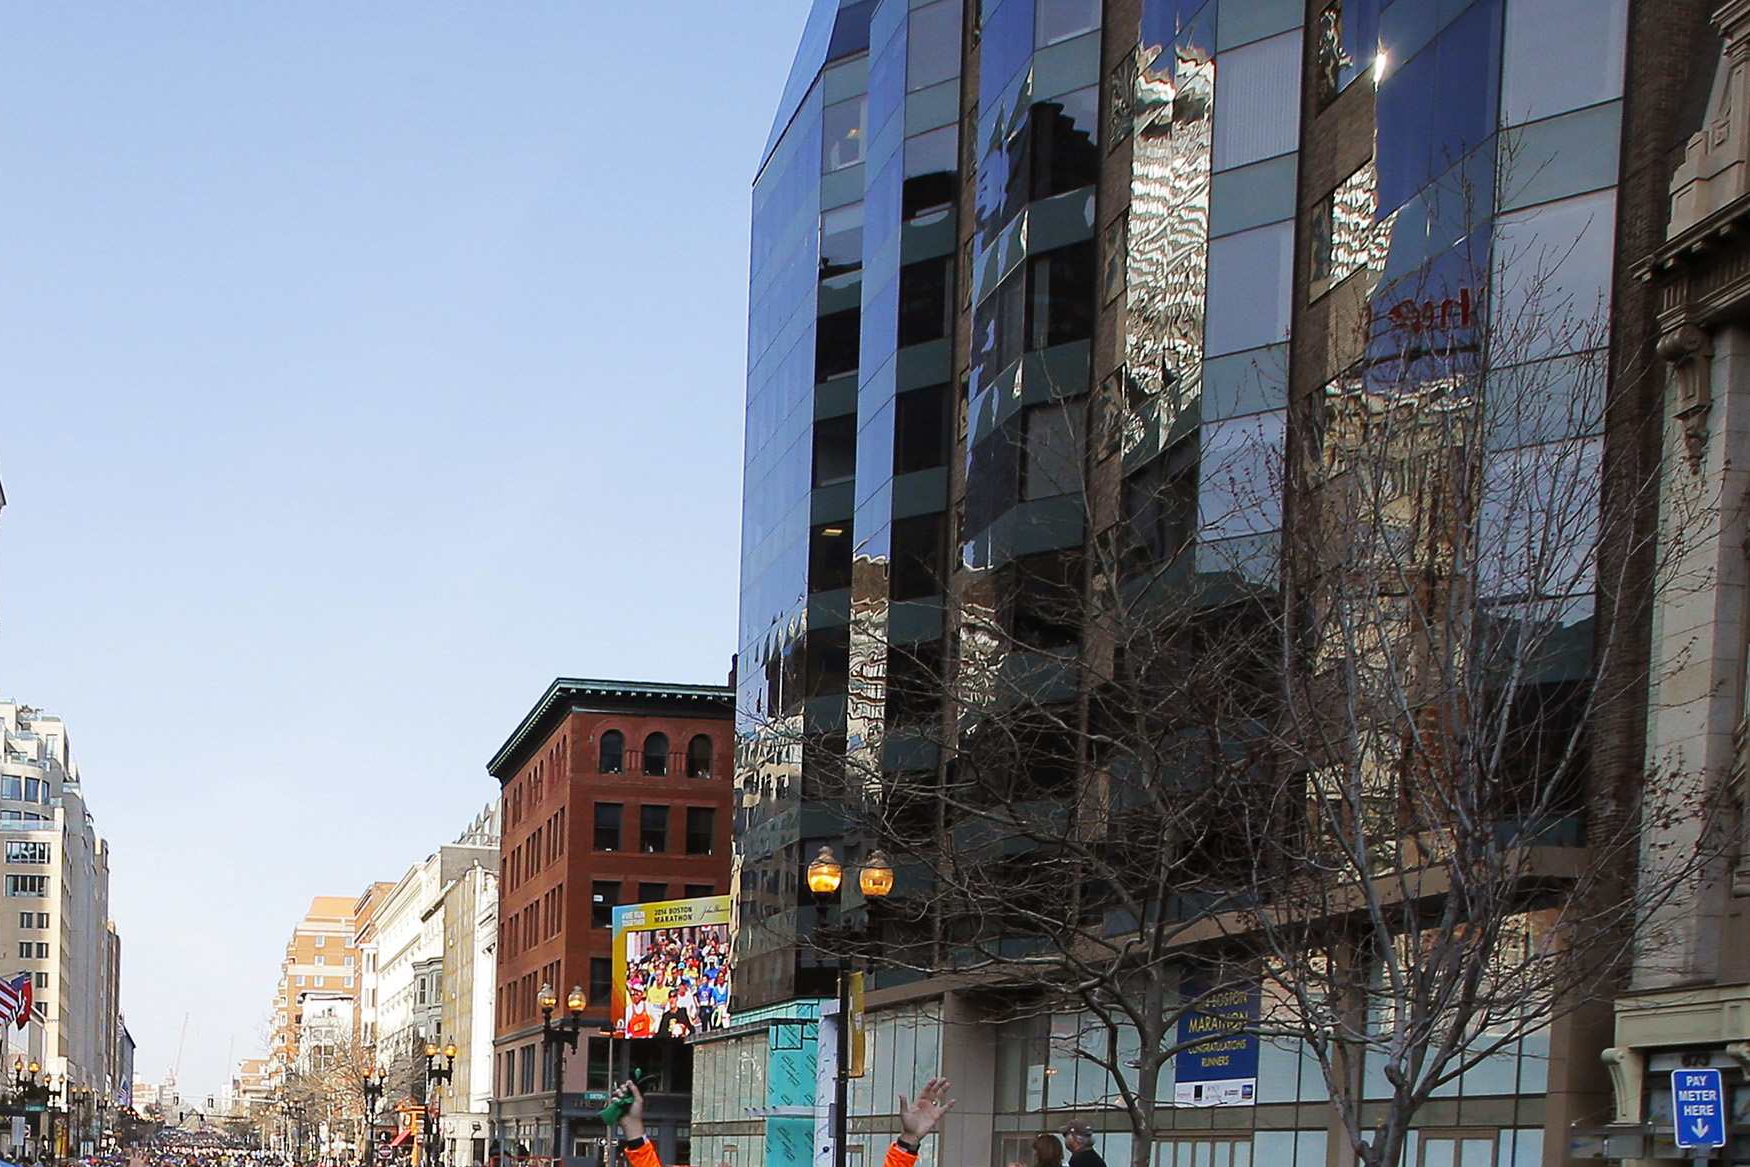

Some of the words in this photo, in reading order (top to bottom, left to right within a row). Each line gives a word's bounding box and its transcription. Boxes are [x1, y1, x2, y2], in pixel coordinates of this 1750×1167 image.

[1686, 1076, 1707, 1087] PAY
[1678, 1090, 1717, 1101] METER
[1684, 1105, 1715, 1116] HERE
